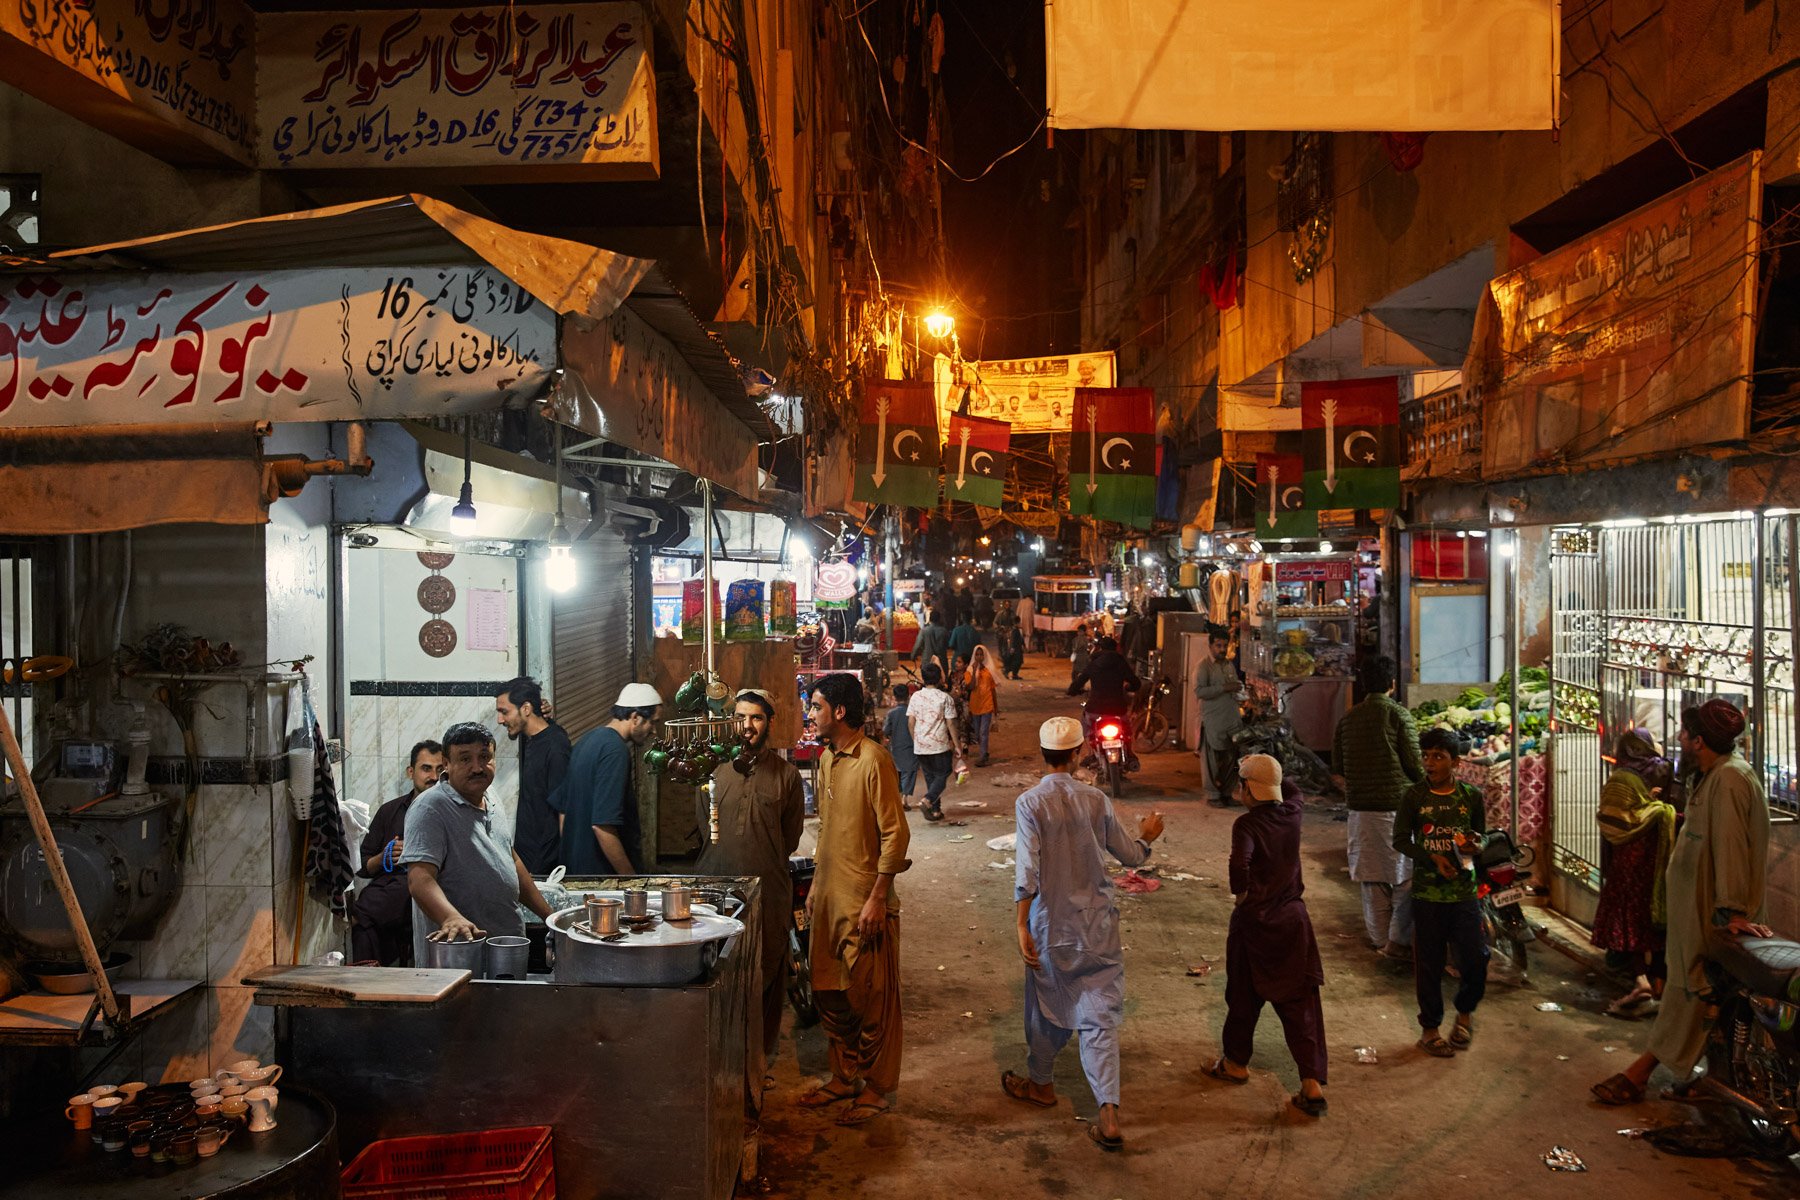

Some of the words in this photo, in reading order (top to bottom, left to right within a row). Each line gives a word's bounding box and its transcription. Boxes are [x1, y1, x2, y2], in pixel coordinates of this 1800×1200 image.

[135, 56, 152, 88] D
[445, 7, 637, 97] عبدالرزاق
[152, 62, 170, 96] 16
[365, 109, 412, 162] بہار
[410, 107, 443, 149] روڈ
[443, 119, 468, 144] D
[469, 109, 500, 138] 16
[533, 99, 588, 127] 734
[570, 107, 604, 154] نمبر
[594, 107, 644, 156] پلاٹ
[273, 111, 334, 166] کراچی
[520, 132, 577, 161] 735
[377, 276, 414, 319] 16
[401, 272, 458, 328] نمبر
[452, 267, 486, 324] گلی
[485, 276, 514, 315] روڈ
[83, 281, 239, 408] کوئٹہ
[213, 283, 309, 404] نیو
[366, 326, 416, 391] کراچی
[403, 338, 455, 377] لیاری
[458, 327, 518, 374] کالونی
[504, 335, 540, 377] بہار
